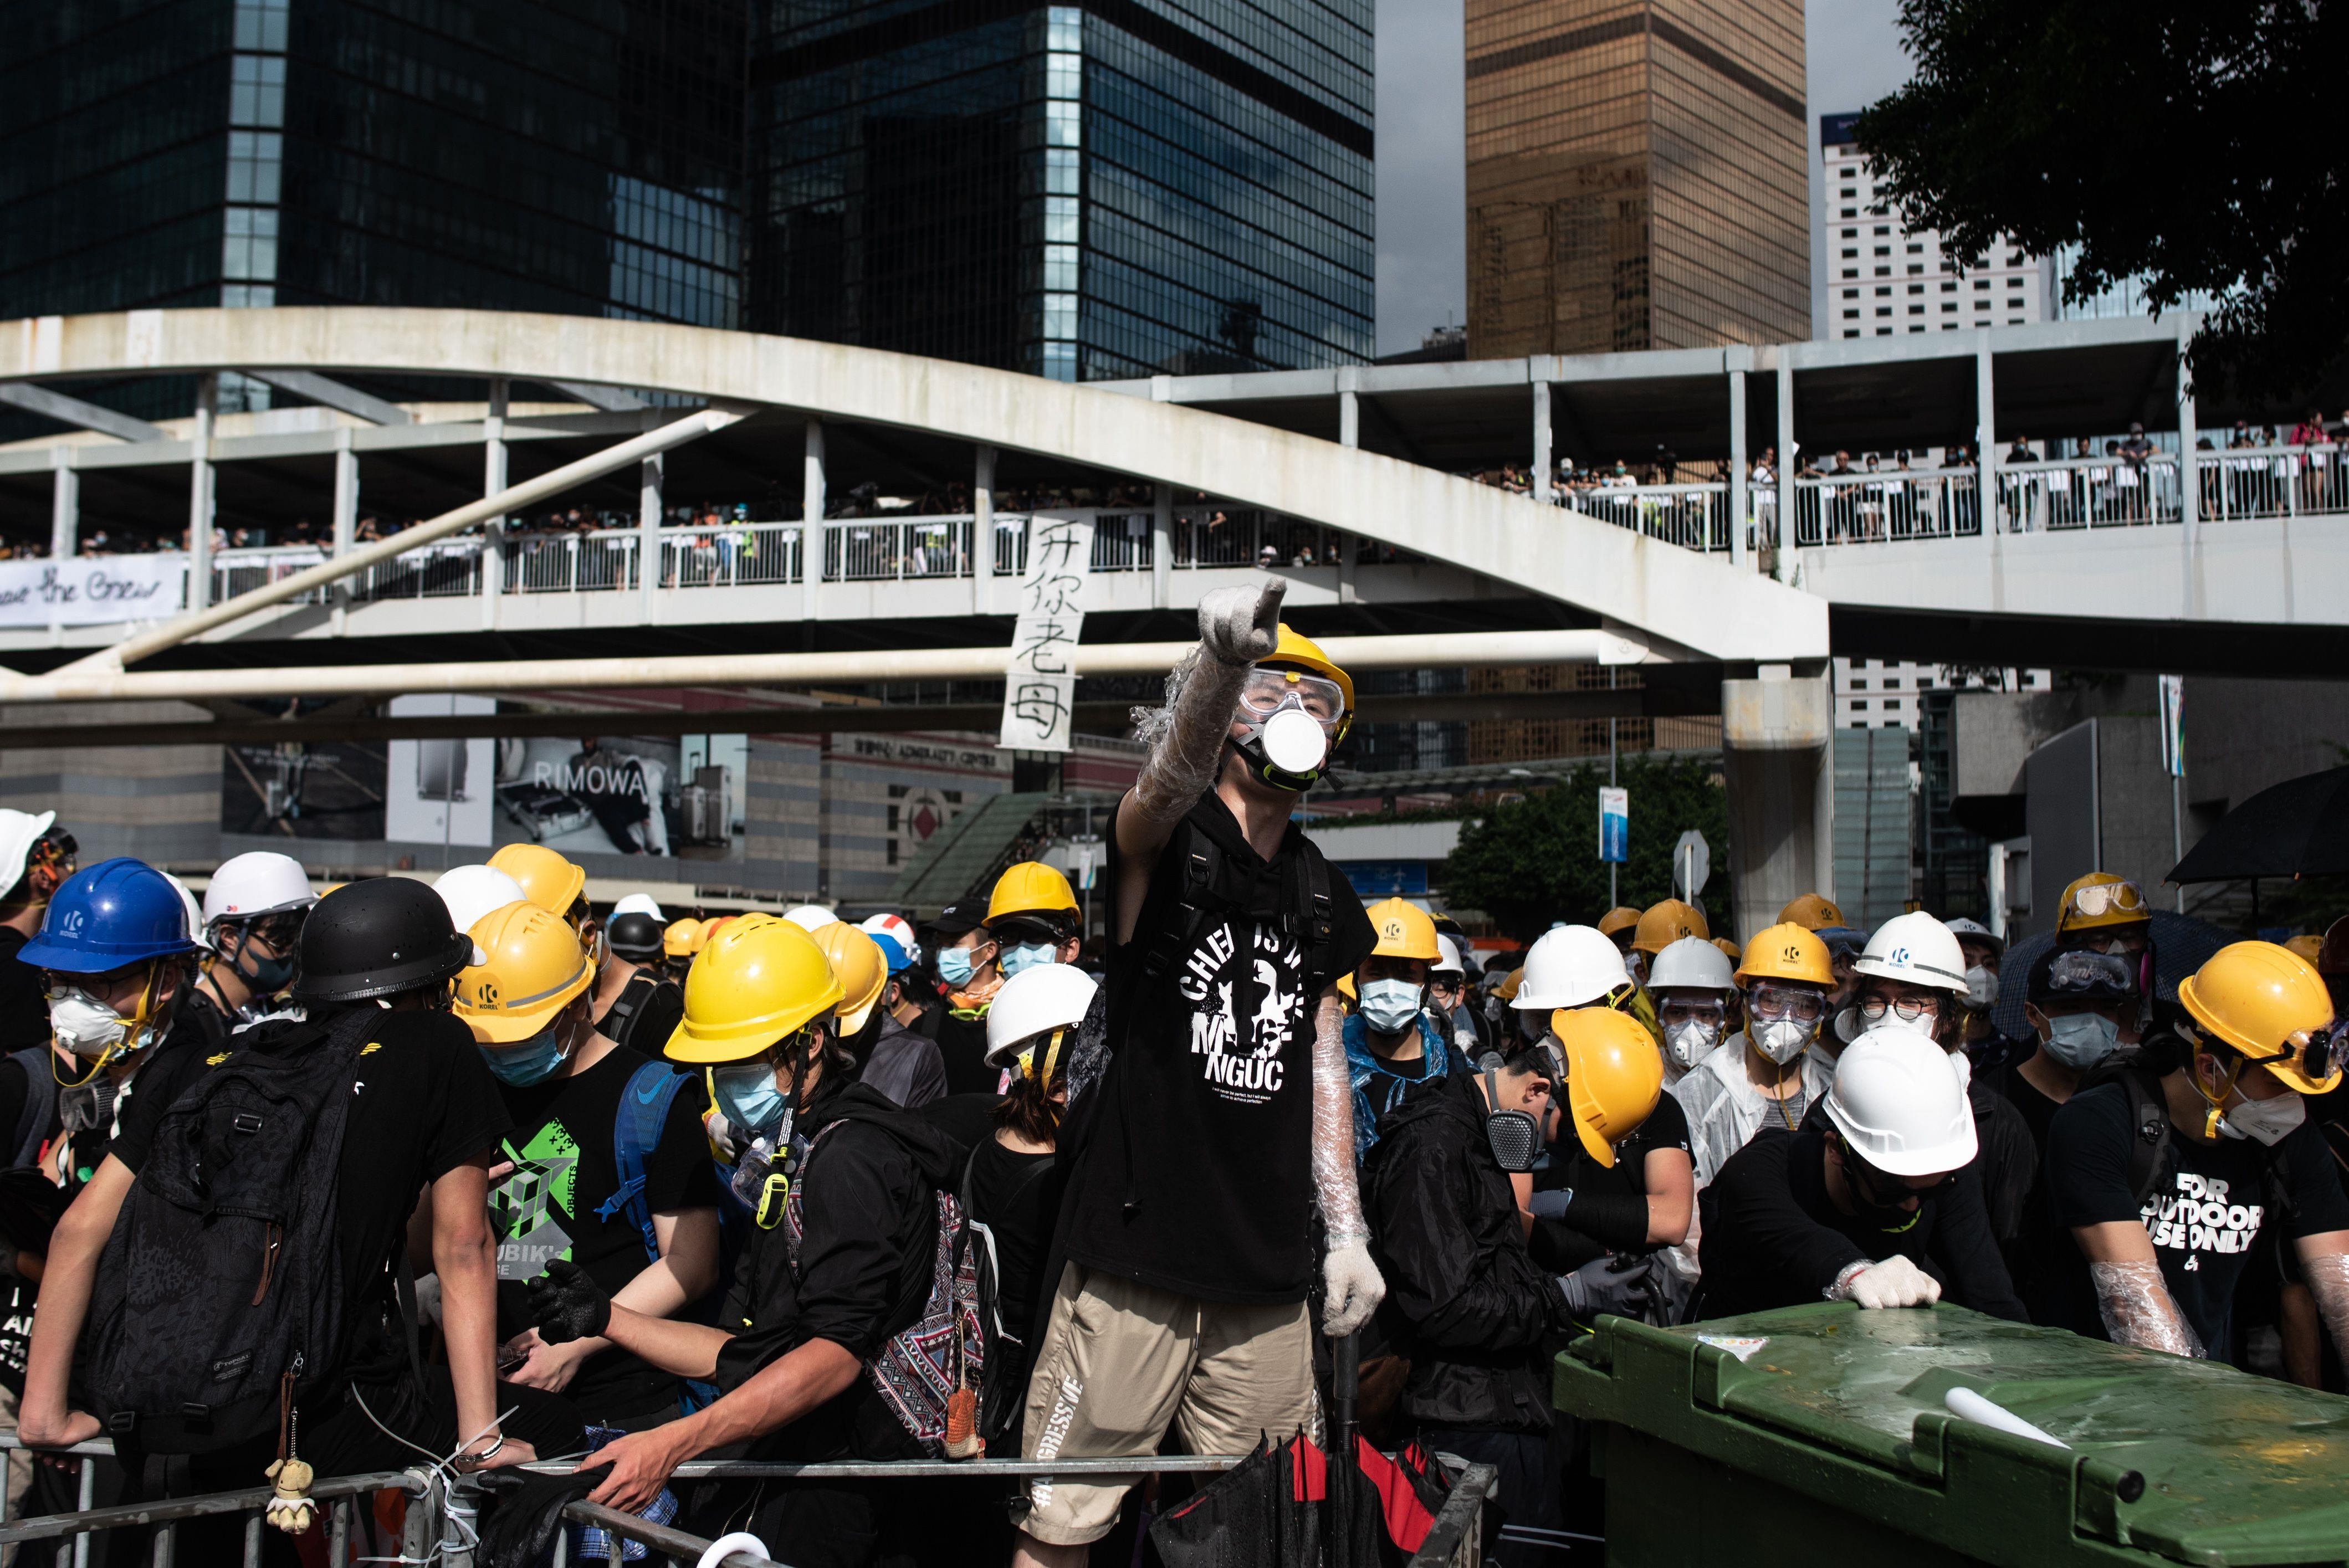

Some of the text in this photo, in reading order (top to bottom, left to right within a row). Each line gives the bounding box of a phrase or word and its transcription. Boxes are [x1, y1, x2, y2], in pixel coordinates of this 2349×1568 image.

[36, 566, 78, 602] the
[534, 761, 646, 796] RIMOWA
[566, 1165, 577, 1214] OBJECTS
[2177, 1172, 2229, 1205] FOR
[2141, 1216, 2258, 1254] USE ONLY
[1031, 1374, 1083, 1508] #AGRESSIVE
